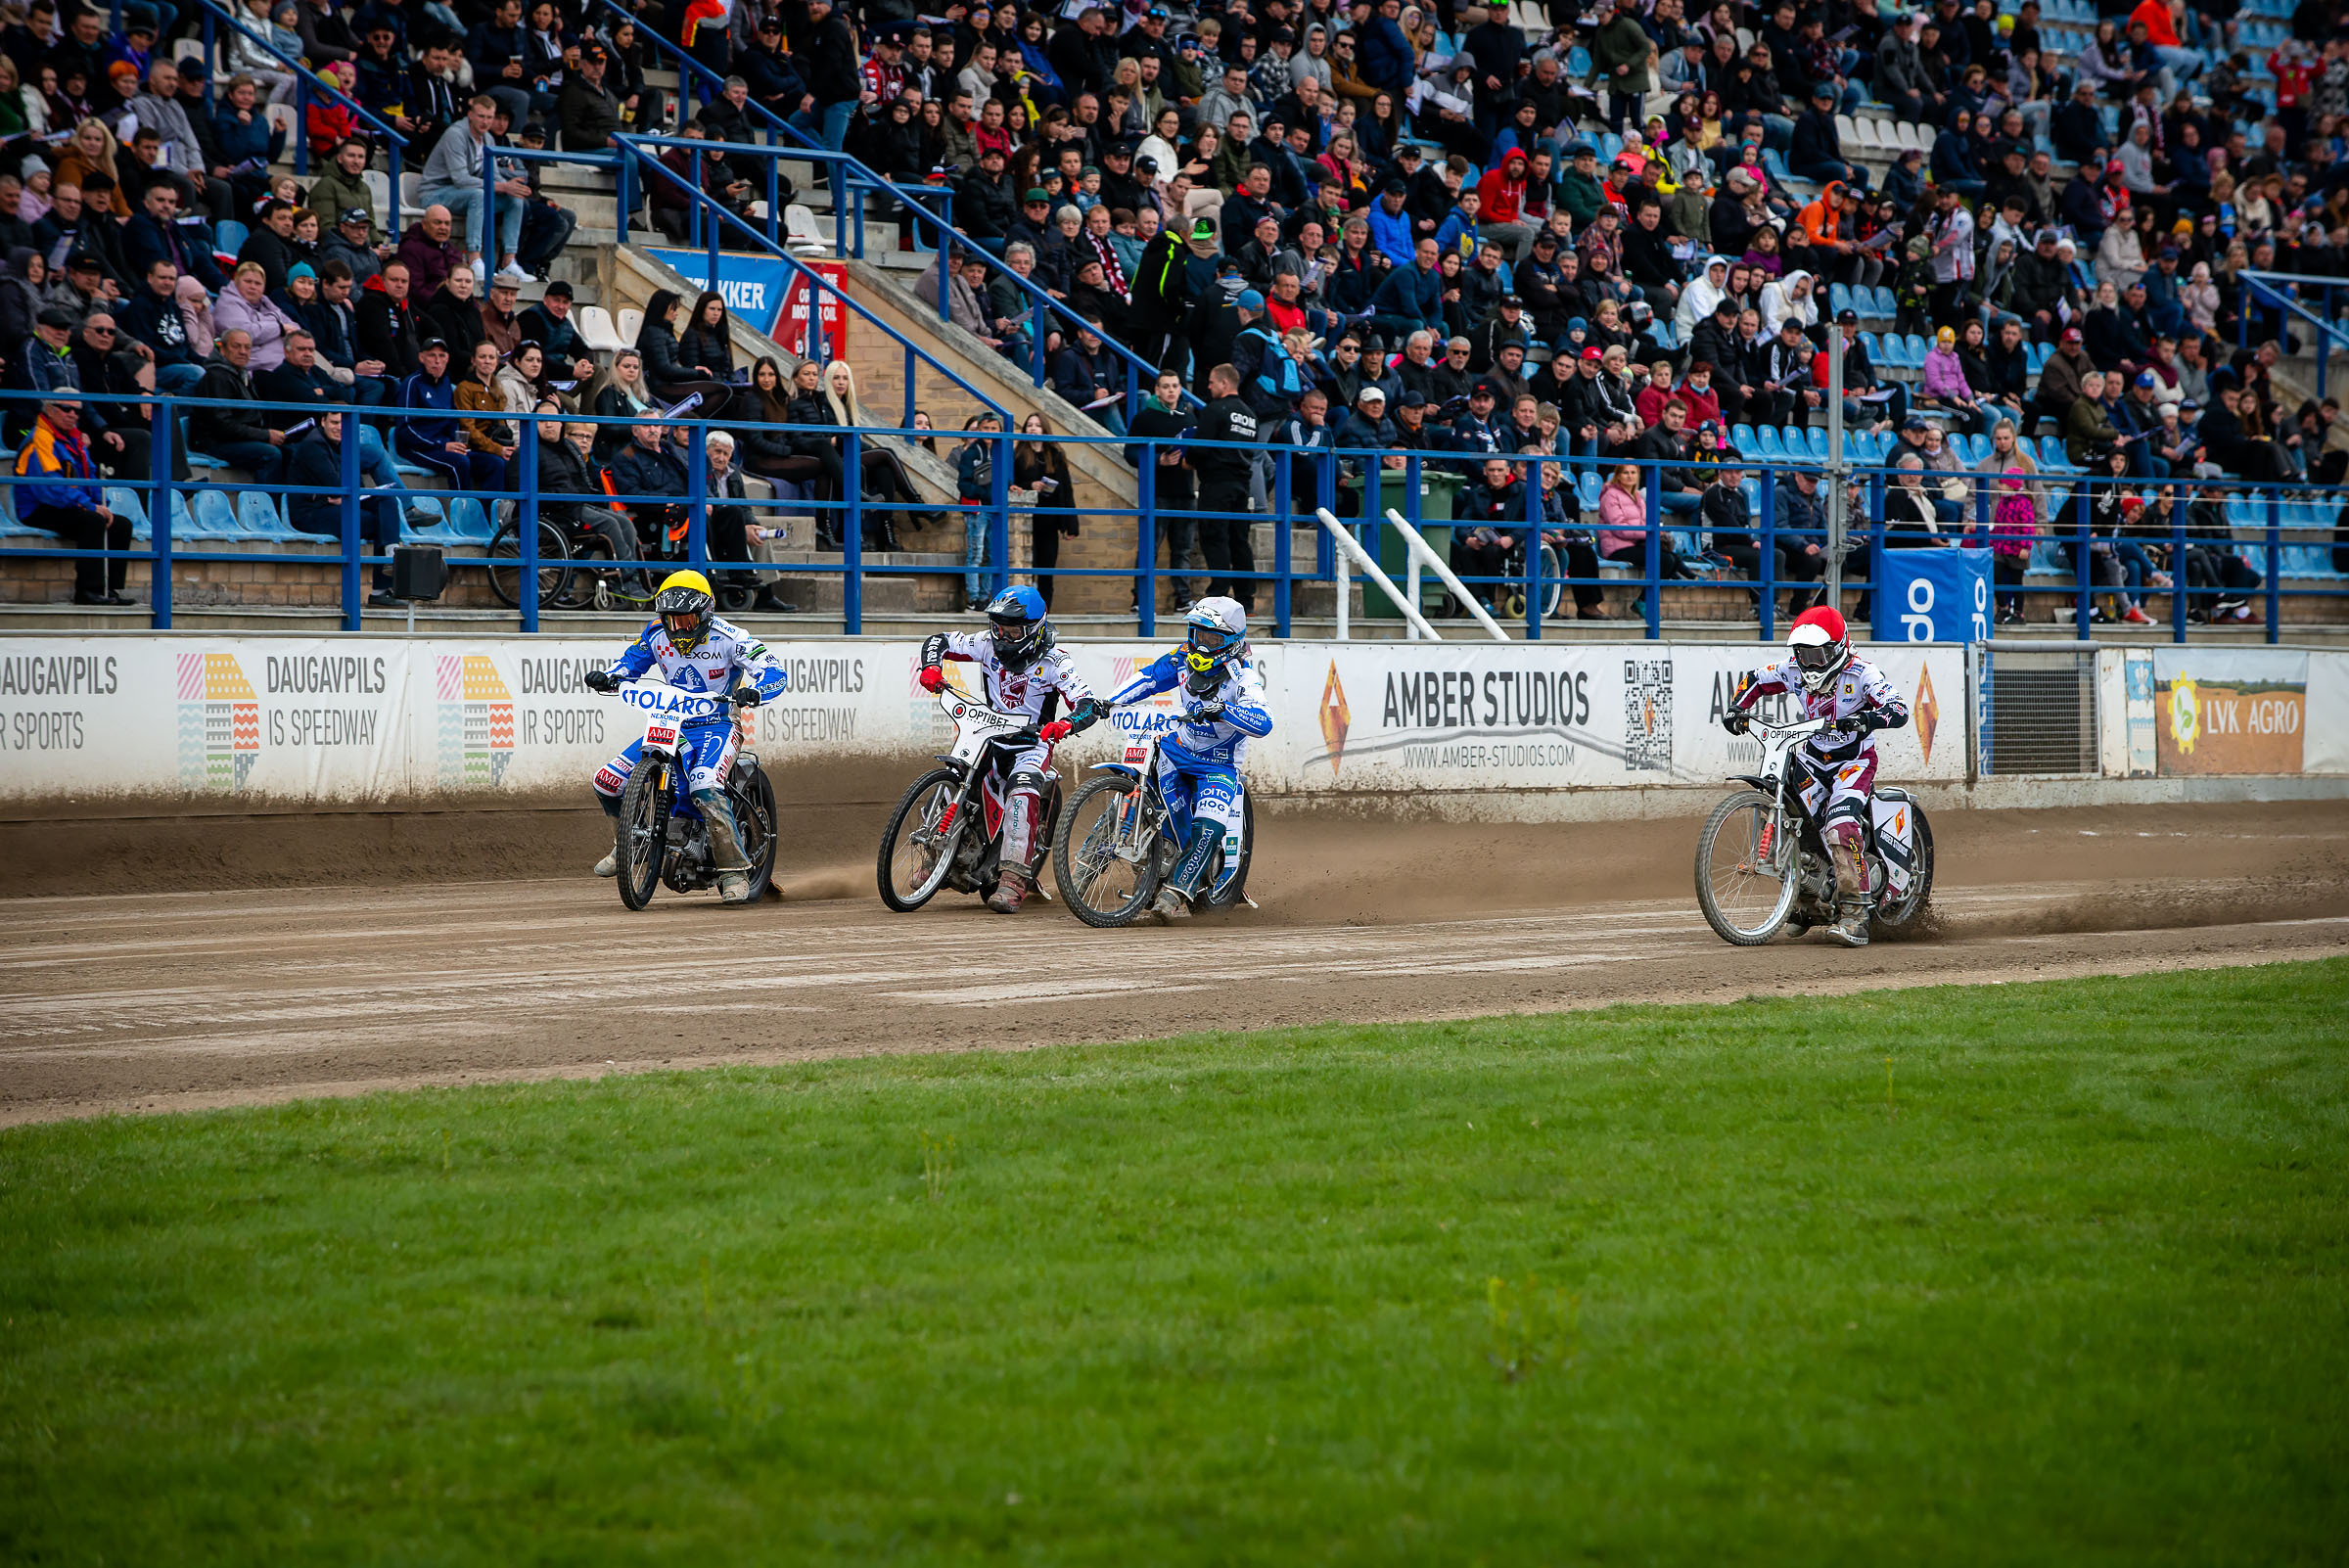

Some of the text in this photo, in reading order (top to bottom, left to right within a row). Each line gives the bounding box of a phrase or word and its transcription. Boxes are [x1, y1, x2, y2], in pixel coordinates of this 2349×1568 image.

[792, 304, 822, 321] MOTR
[1229, 411, 1257, 430] GROM
[679, 651, 722, 661] EXOM
[0, 657, 116, 695] AUGAVPILS
[267, 657, 385, 693] DAUGAVPILS
[522, 658, 613, 694] DAUGAVP
[782, 659, 863, 693] UGAVPILS
[1383, 670, 1589, 727] AMBER STUDIOS
[0, 711, 84, 751] R SPORTS
[269, 710, 378, 746] IS SPEEDWAY
[523, 709, 605, 744] IR SPORTS
[762, 708, 776, 743] IS
[782, 708, 857, 742] SPEEDWAY
[968, 708, 1009, 728] OPTIBET
[2207, 700, 2299, 734] LVK AGRO
[649, 728, 675, 739] AMD
[1771, 730, 1800, 739] OPTIBET
[1125, 749, 1146, 758] AMD
[1404, 745, 1575, 768] WWW.AMBER-STUDIOS.COM
[597, 769, 622, 787] AMD
[1199, 801, 1225, 816] HOG
